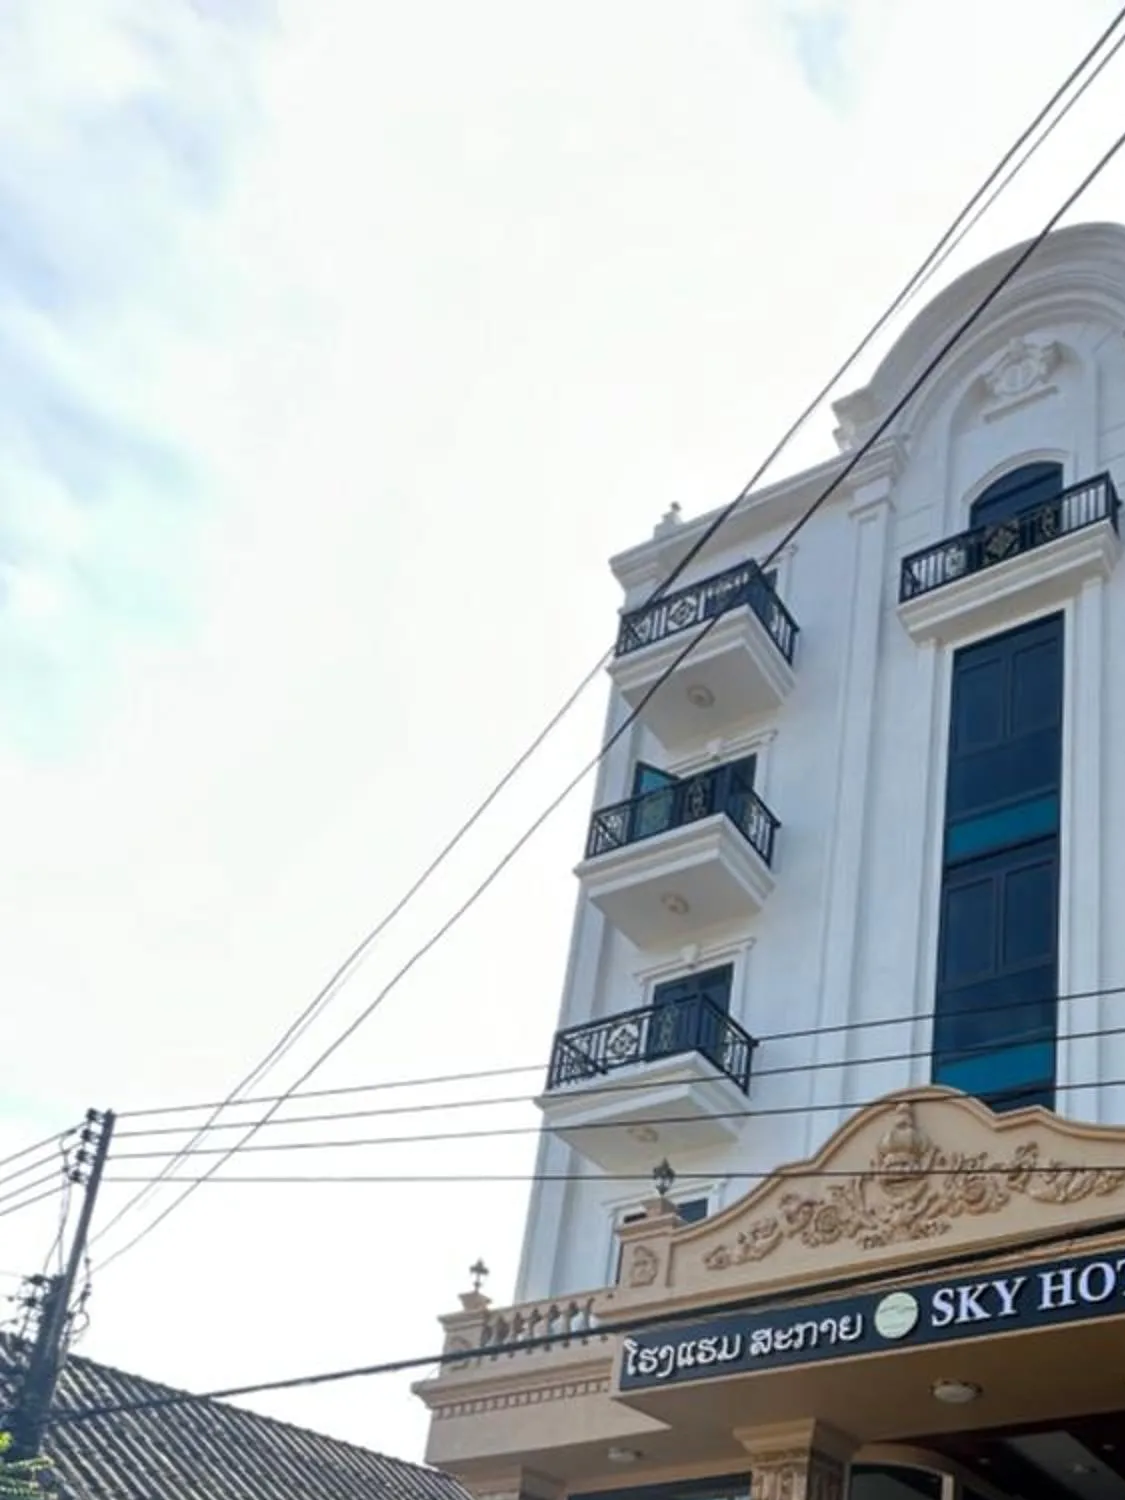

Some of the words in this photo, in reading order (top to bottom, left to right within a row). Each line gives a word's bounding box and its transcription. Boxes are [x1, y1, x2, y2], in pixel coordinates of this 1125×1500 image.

[931, 1275, 1028, 1327] SKY
[624, 1333, 741, 1378] ໂຮງແຮມ
